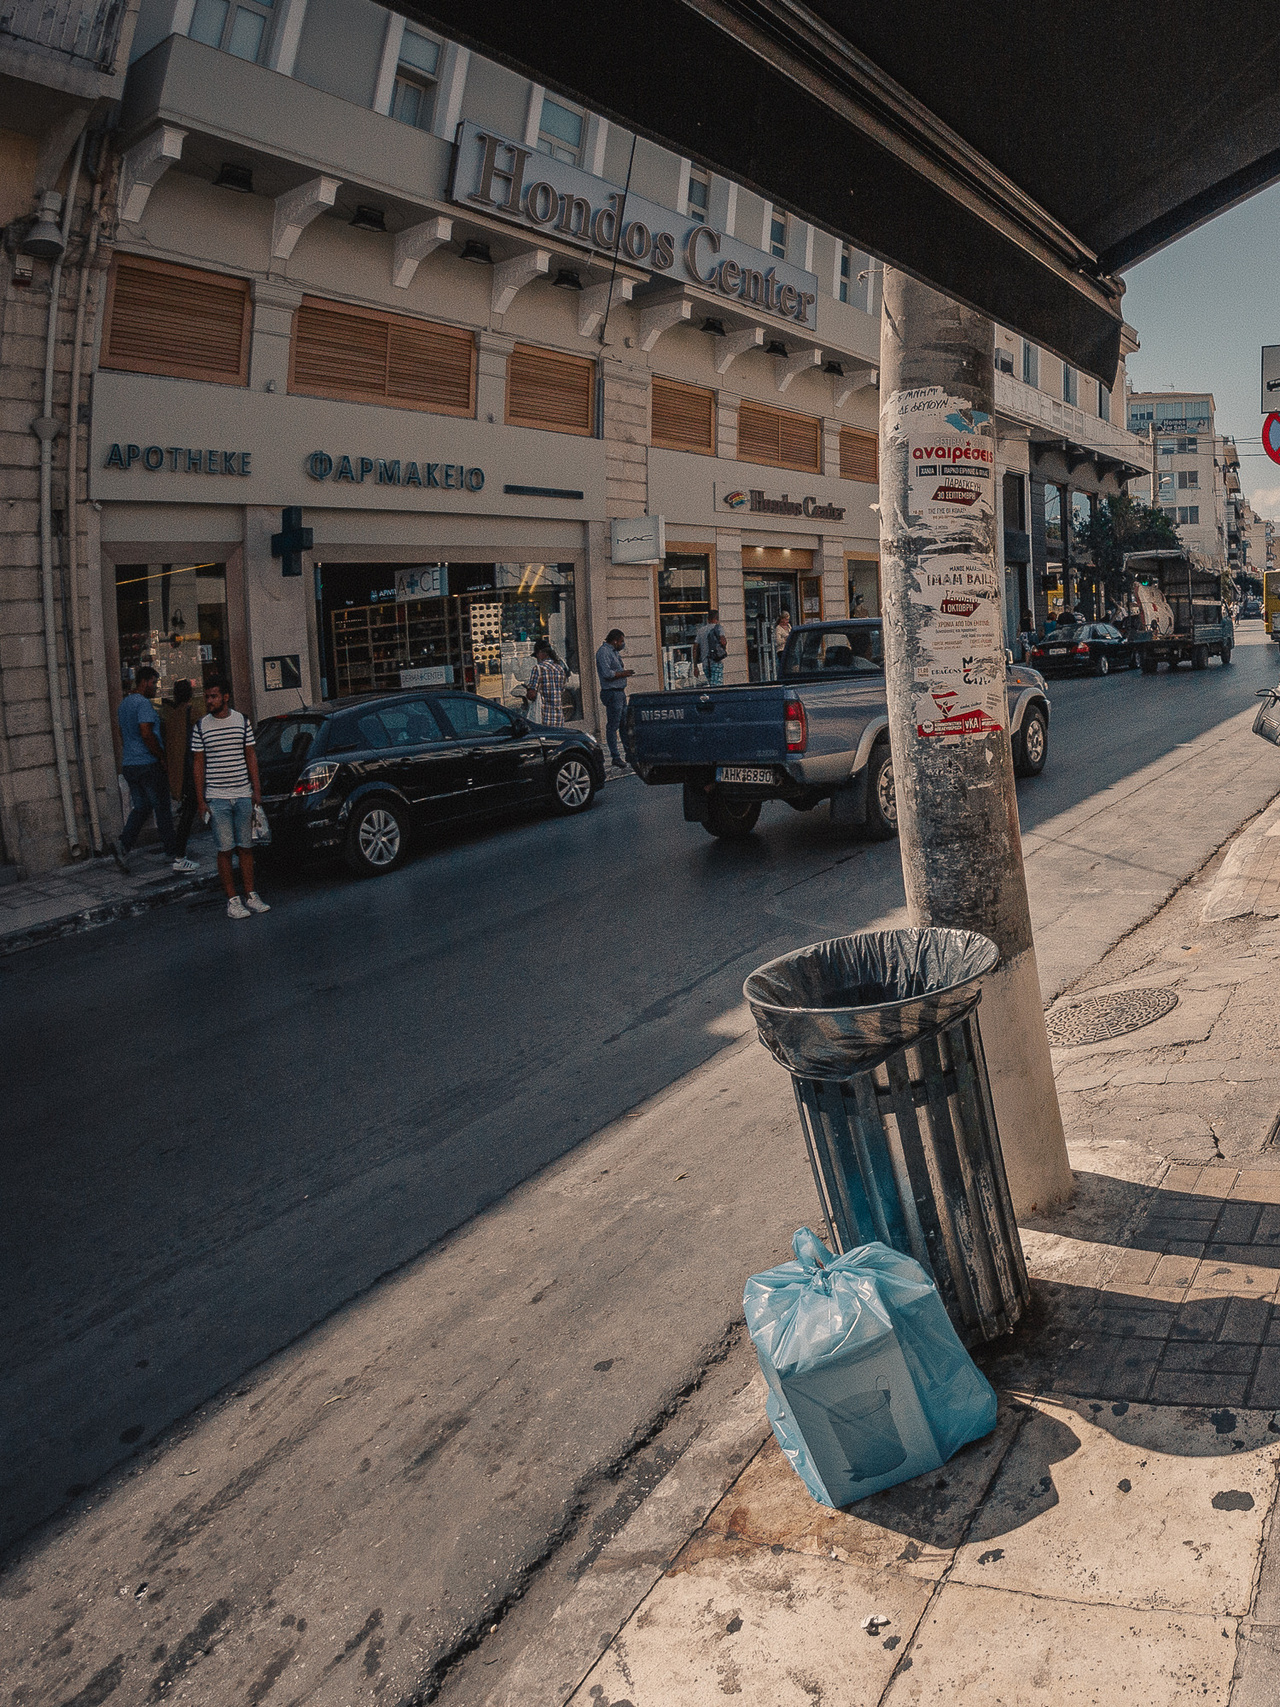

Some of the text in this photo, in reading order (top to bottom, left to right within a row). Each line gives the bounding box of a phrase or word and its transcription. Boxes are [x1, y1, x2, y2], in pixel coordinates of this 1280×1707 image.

[466, 131, 816, 323] Hondos Center
[104, 443, 252, 476] APOTHEKE
[306, 450, 487, 492] ΦΑΡΜΑΚΕΙΟ
[749, 489, 846, 520] Hondos Center
[936, 491, 945, 500] 30
[927, 573, 963, 586] IMAM
[641, 708, 685, 721] NISSAN
